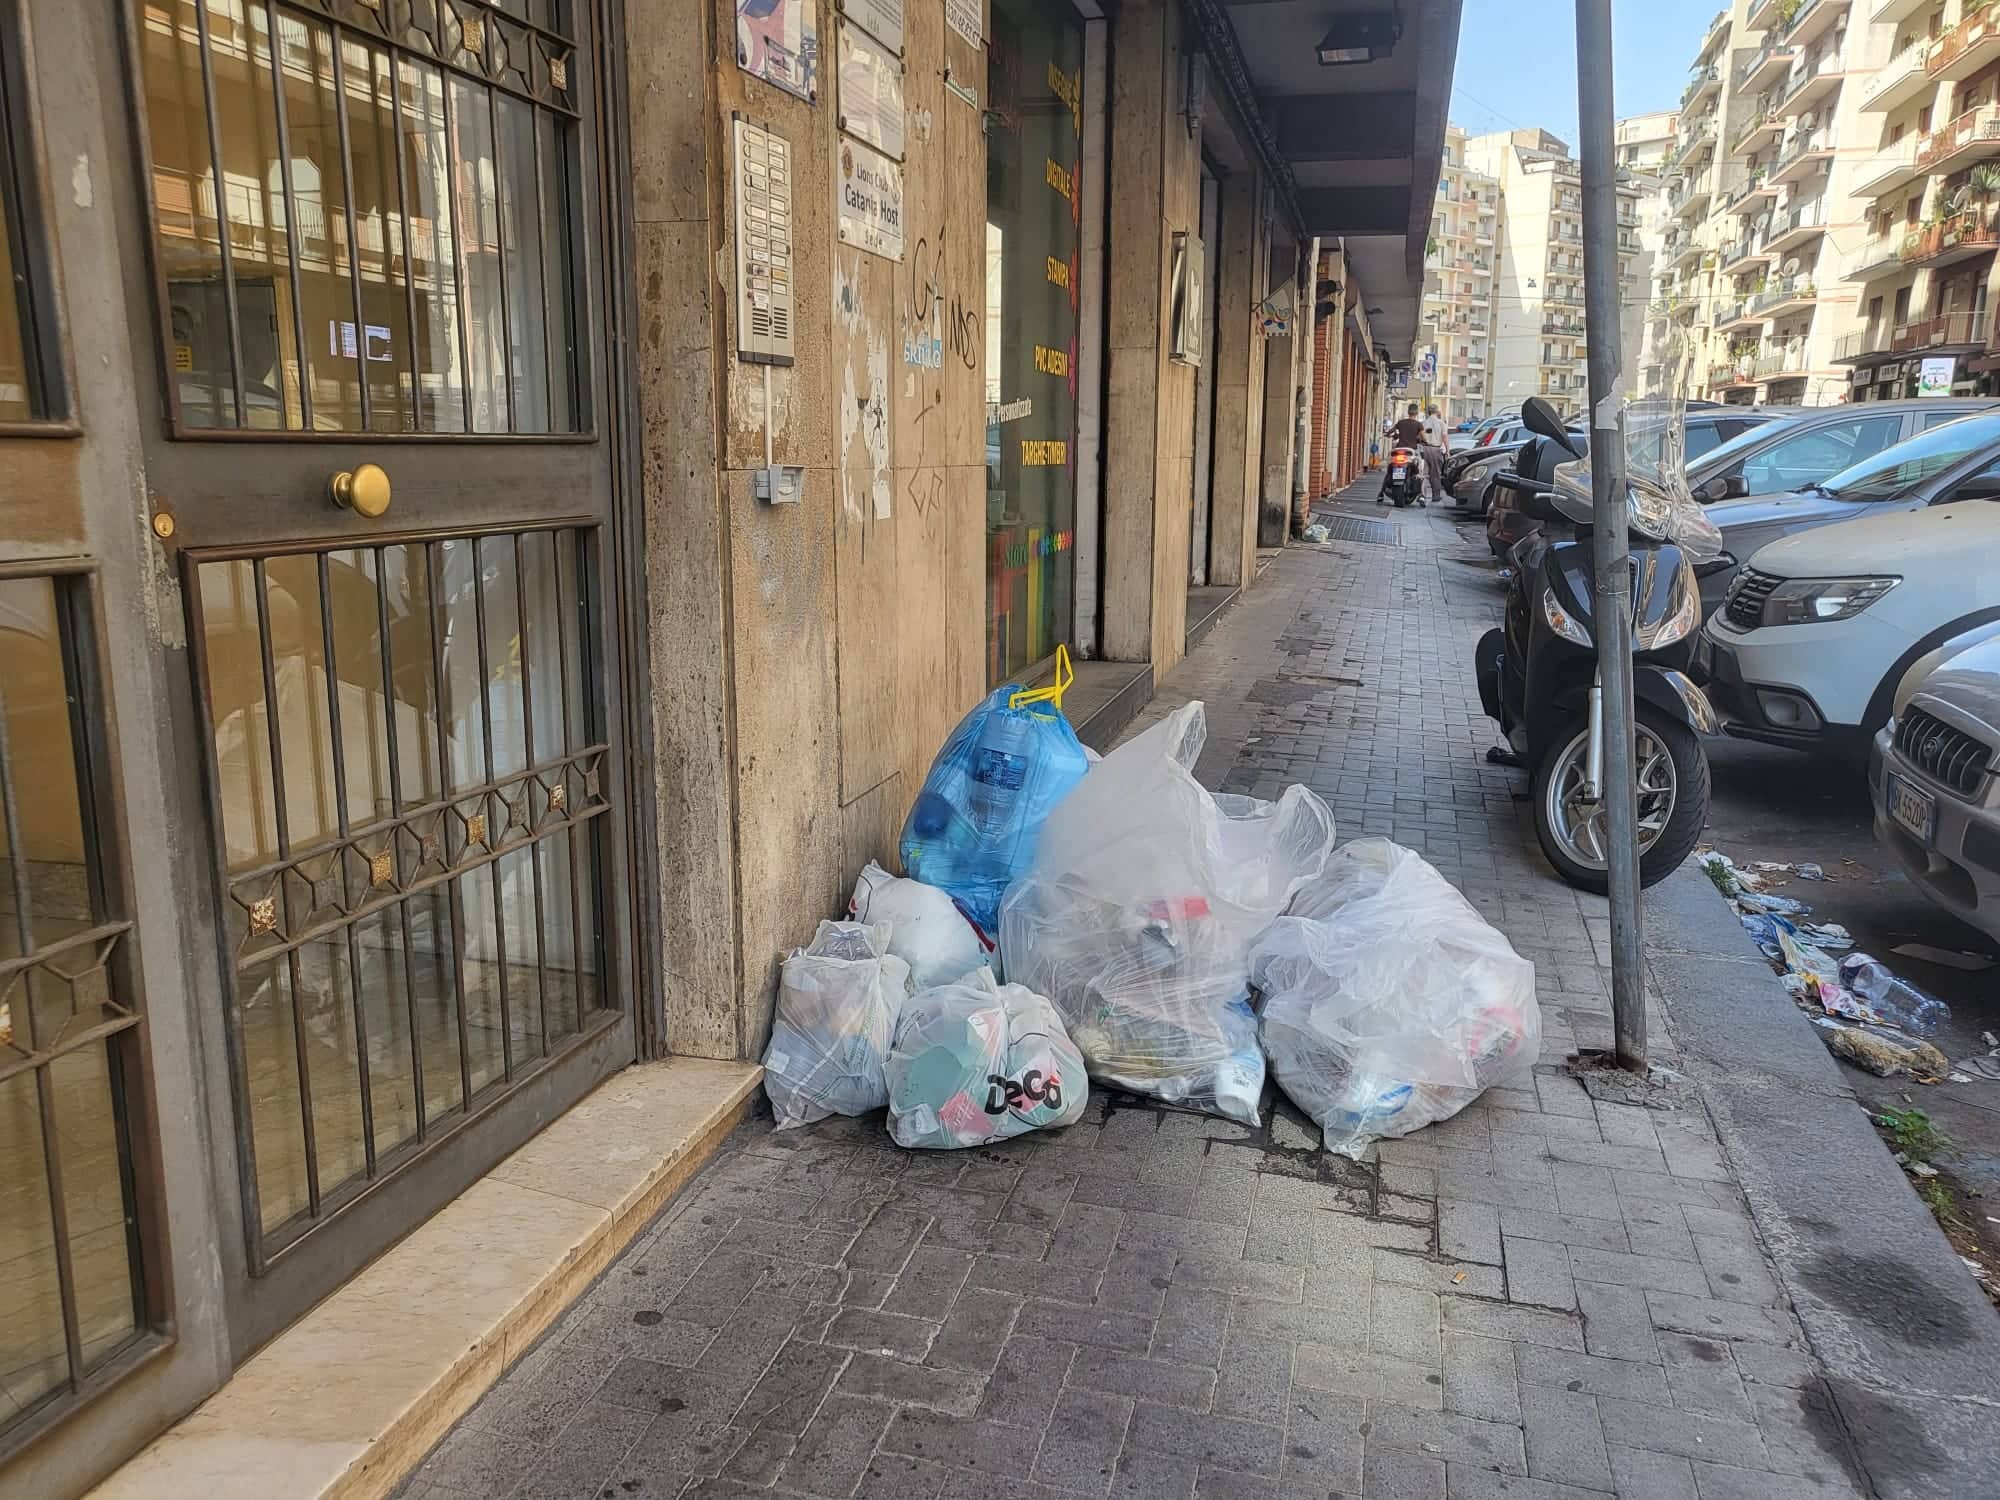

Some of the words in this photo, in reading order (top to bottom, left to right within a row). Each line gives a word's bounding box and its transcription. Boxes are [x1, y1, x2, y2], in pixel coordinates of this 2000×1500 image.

[857, 162, 873, 185] Lions
[875, 172, 889, 192] Club
[1046, 157, 1071, 200] DIGITALE
[845, 184, 877, 217] Catania
[880, 199, 898, 227] Host
[1047, 256, 1068, 288] STAMPA
[1035, 344, 1047, 373] PVC
